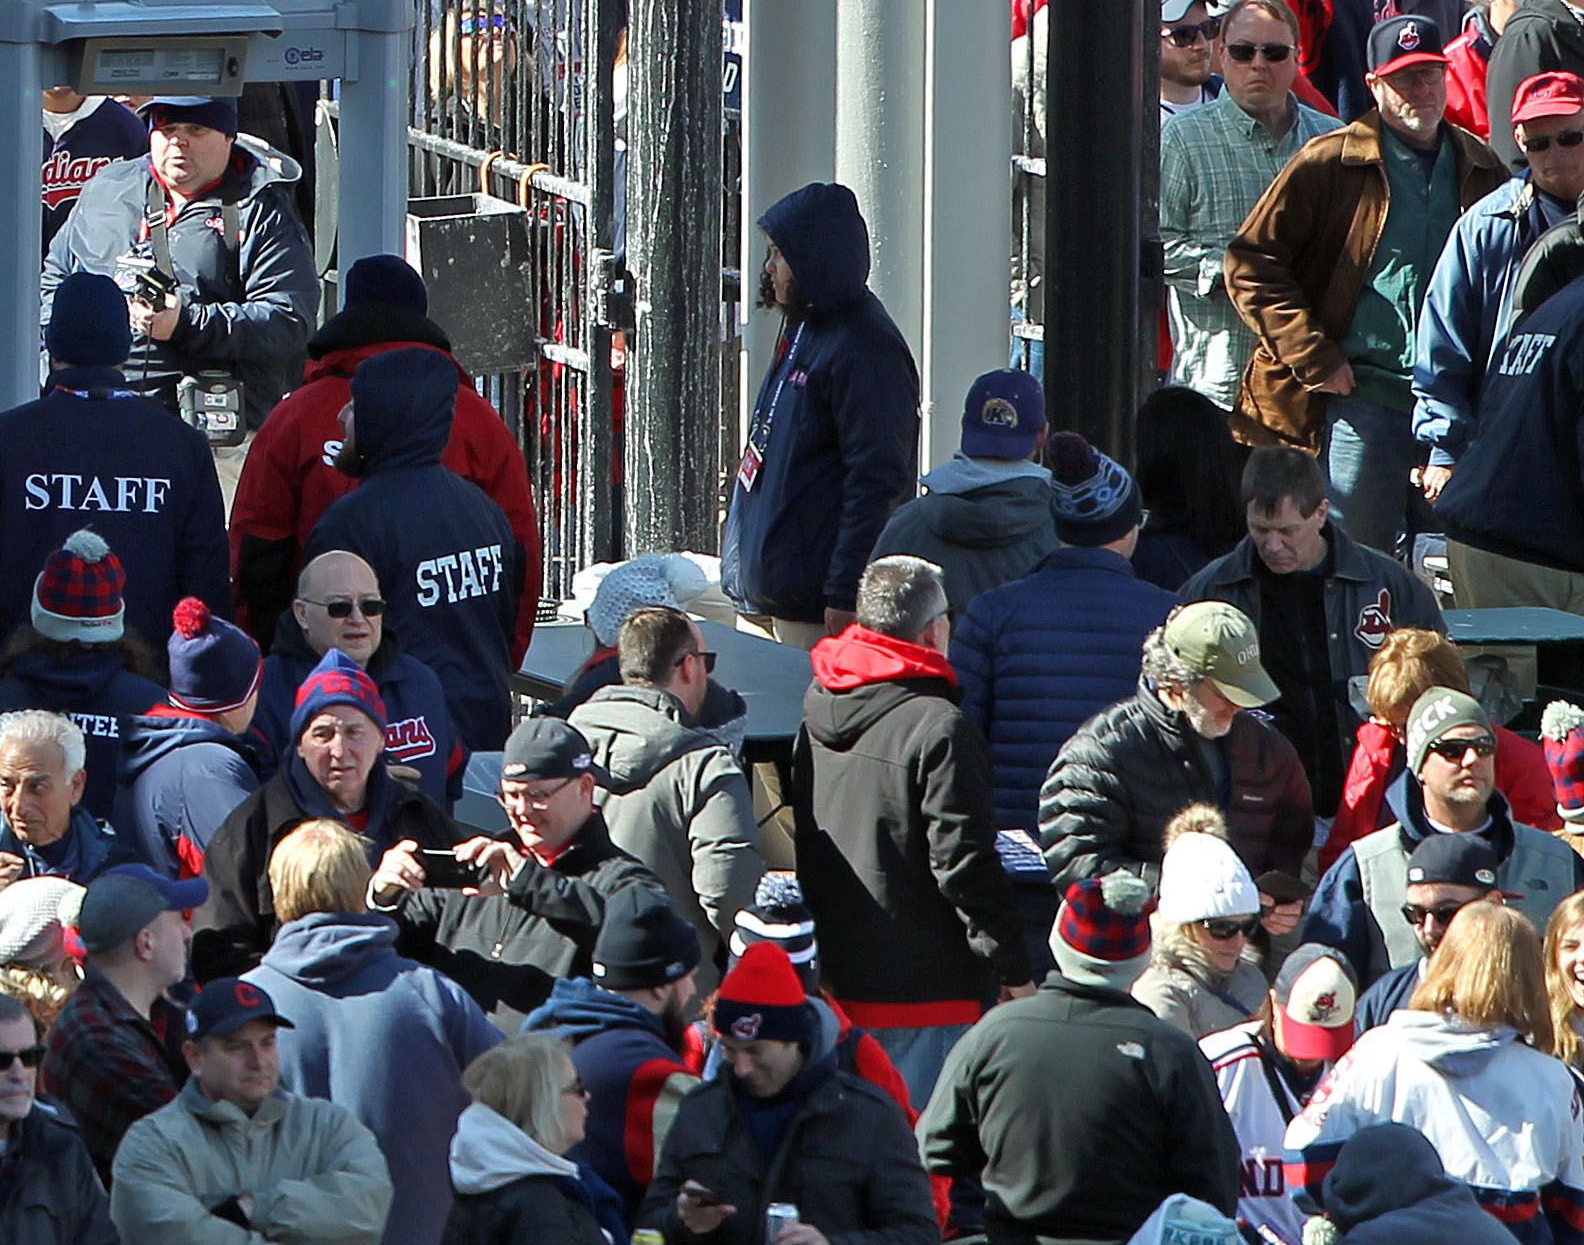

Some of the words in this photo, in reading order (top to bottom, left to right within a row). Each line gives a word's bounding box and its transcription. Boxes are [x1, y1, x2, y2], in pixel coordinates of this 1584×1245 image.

[25, 474, 171, 513] STAFF
[416, 544, 503, 607] STAFF
[236, 983, 260, 1006] C
